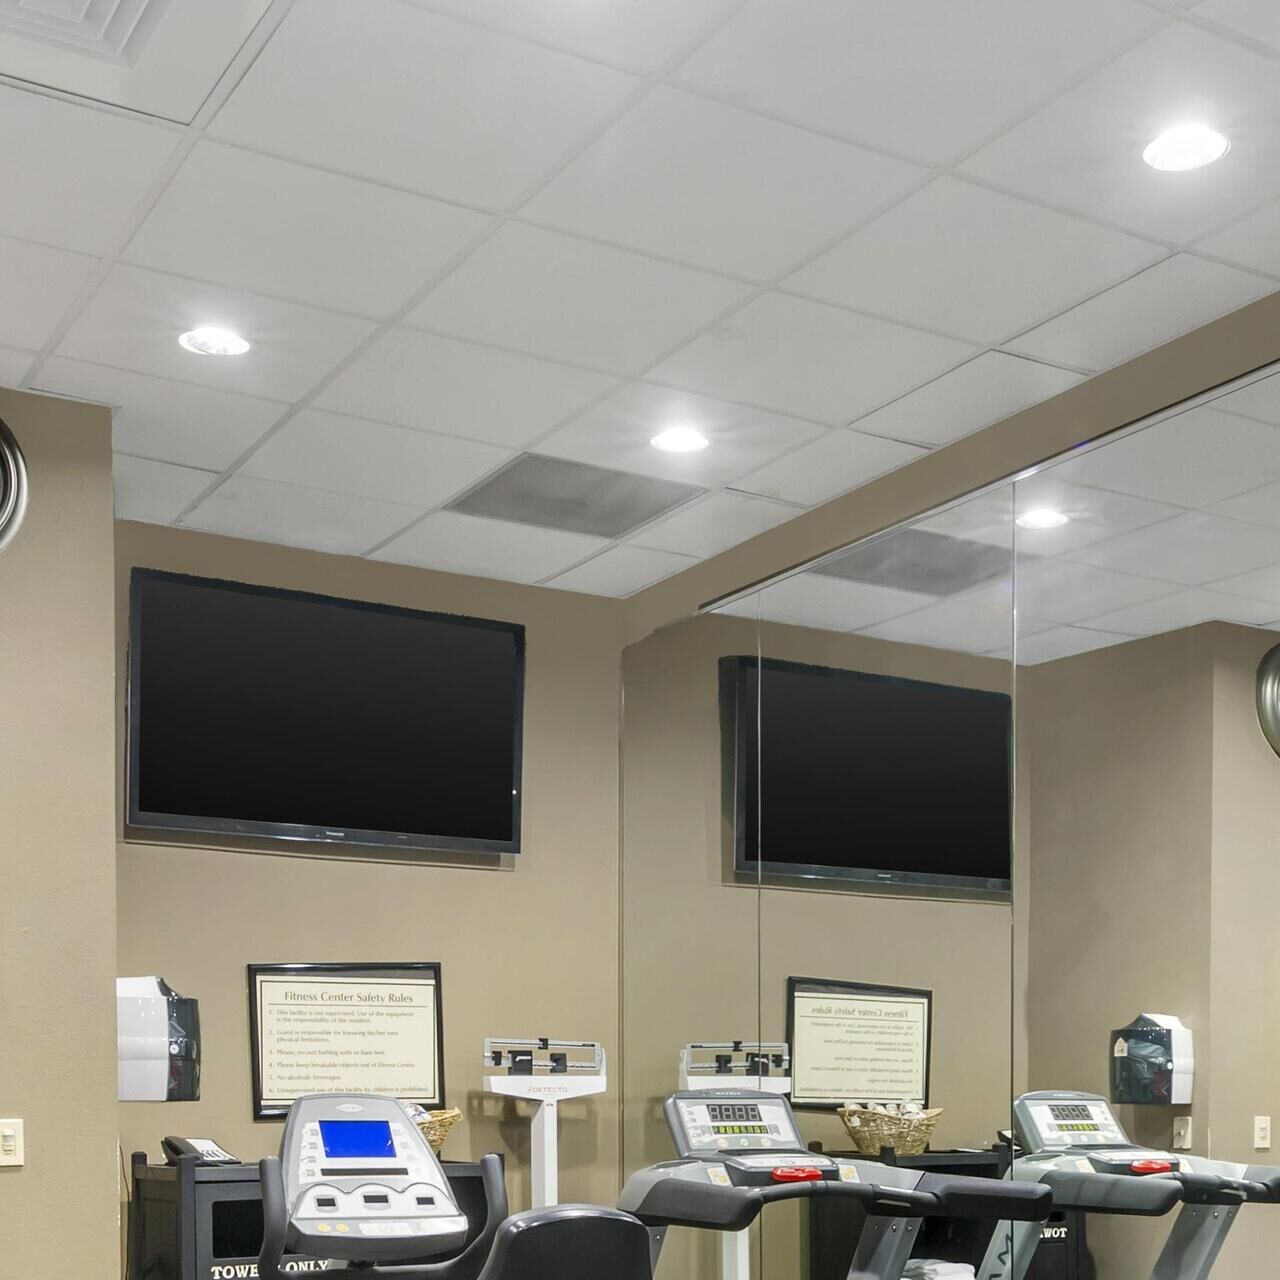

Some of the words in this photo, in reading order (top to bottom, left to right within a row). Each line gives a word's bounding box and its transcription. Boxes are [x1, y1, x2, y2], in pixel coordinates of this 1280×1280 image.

[284, 991, 317, 1001] Fitness
[320, 991, 353, 1001] Center
[356, 992, 385, 1003] Safety
[388, 992, 413, 1002] Rules
